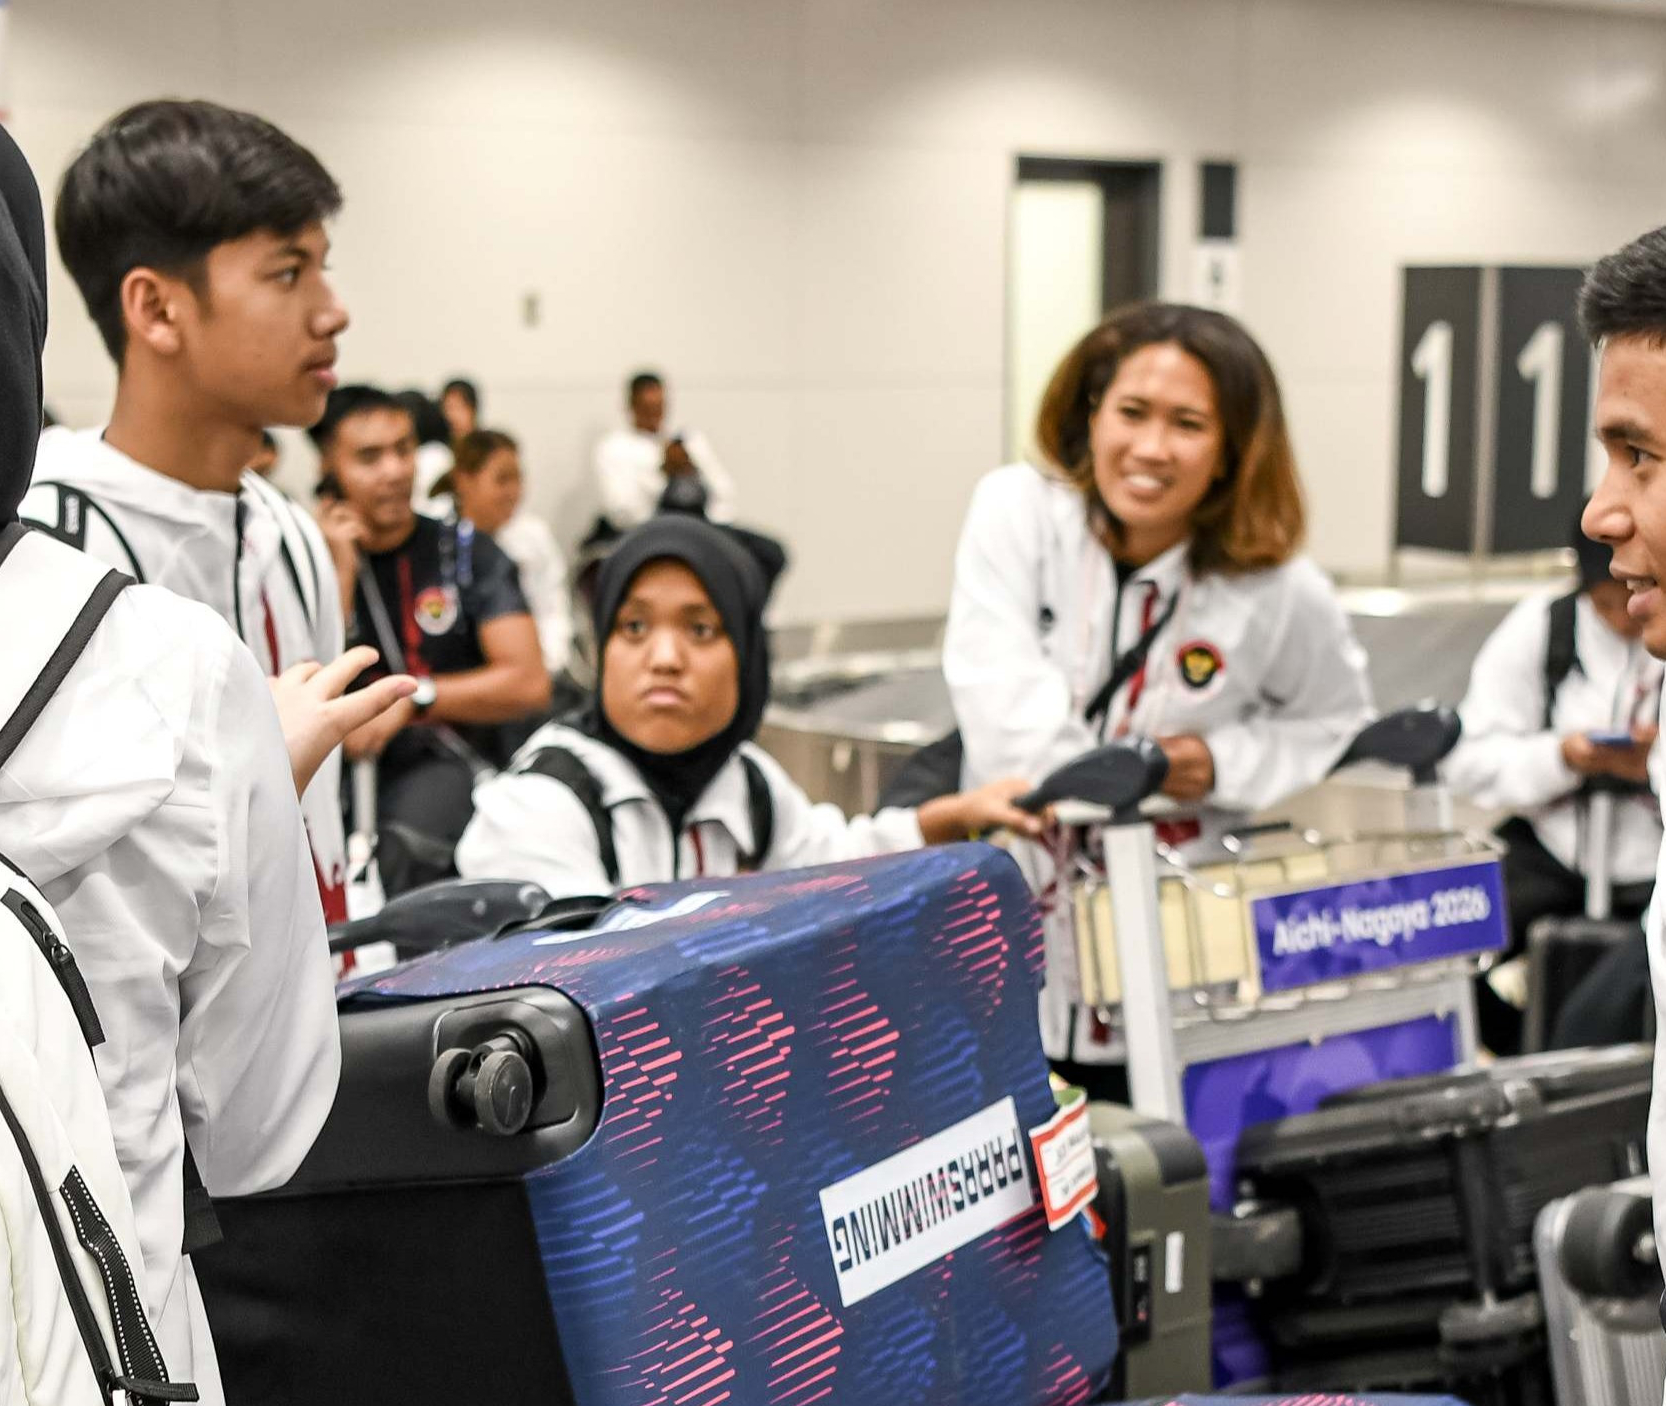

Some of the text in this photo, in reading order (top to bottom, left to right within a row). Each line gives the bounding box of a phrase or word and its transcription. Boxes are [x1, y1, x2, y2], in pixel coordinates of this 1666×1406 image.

[1273, 884, 1491, 957] Aichi-Nagoya 2026
[833, 1126, 1024, 1273] PARASWIMMING
